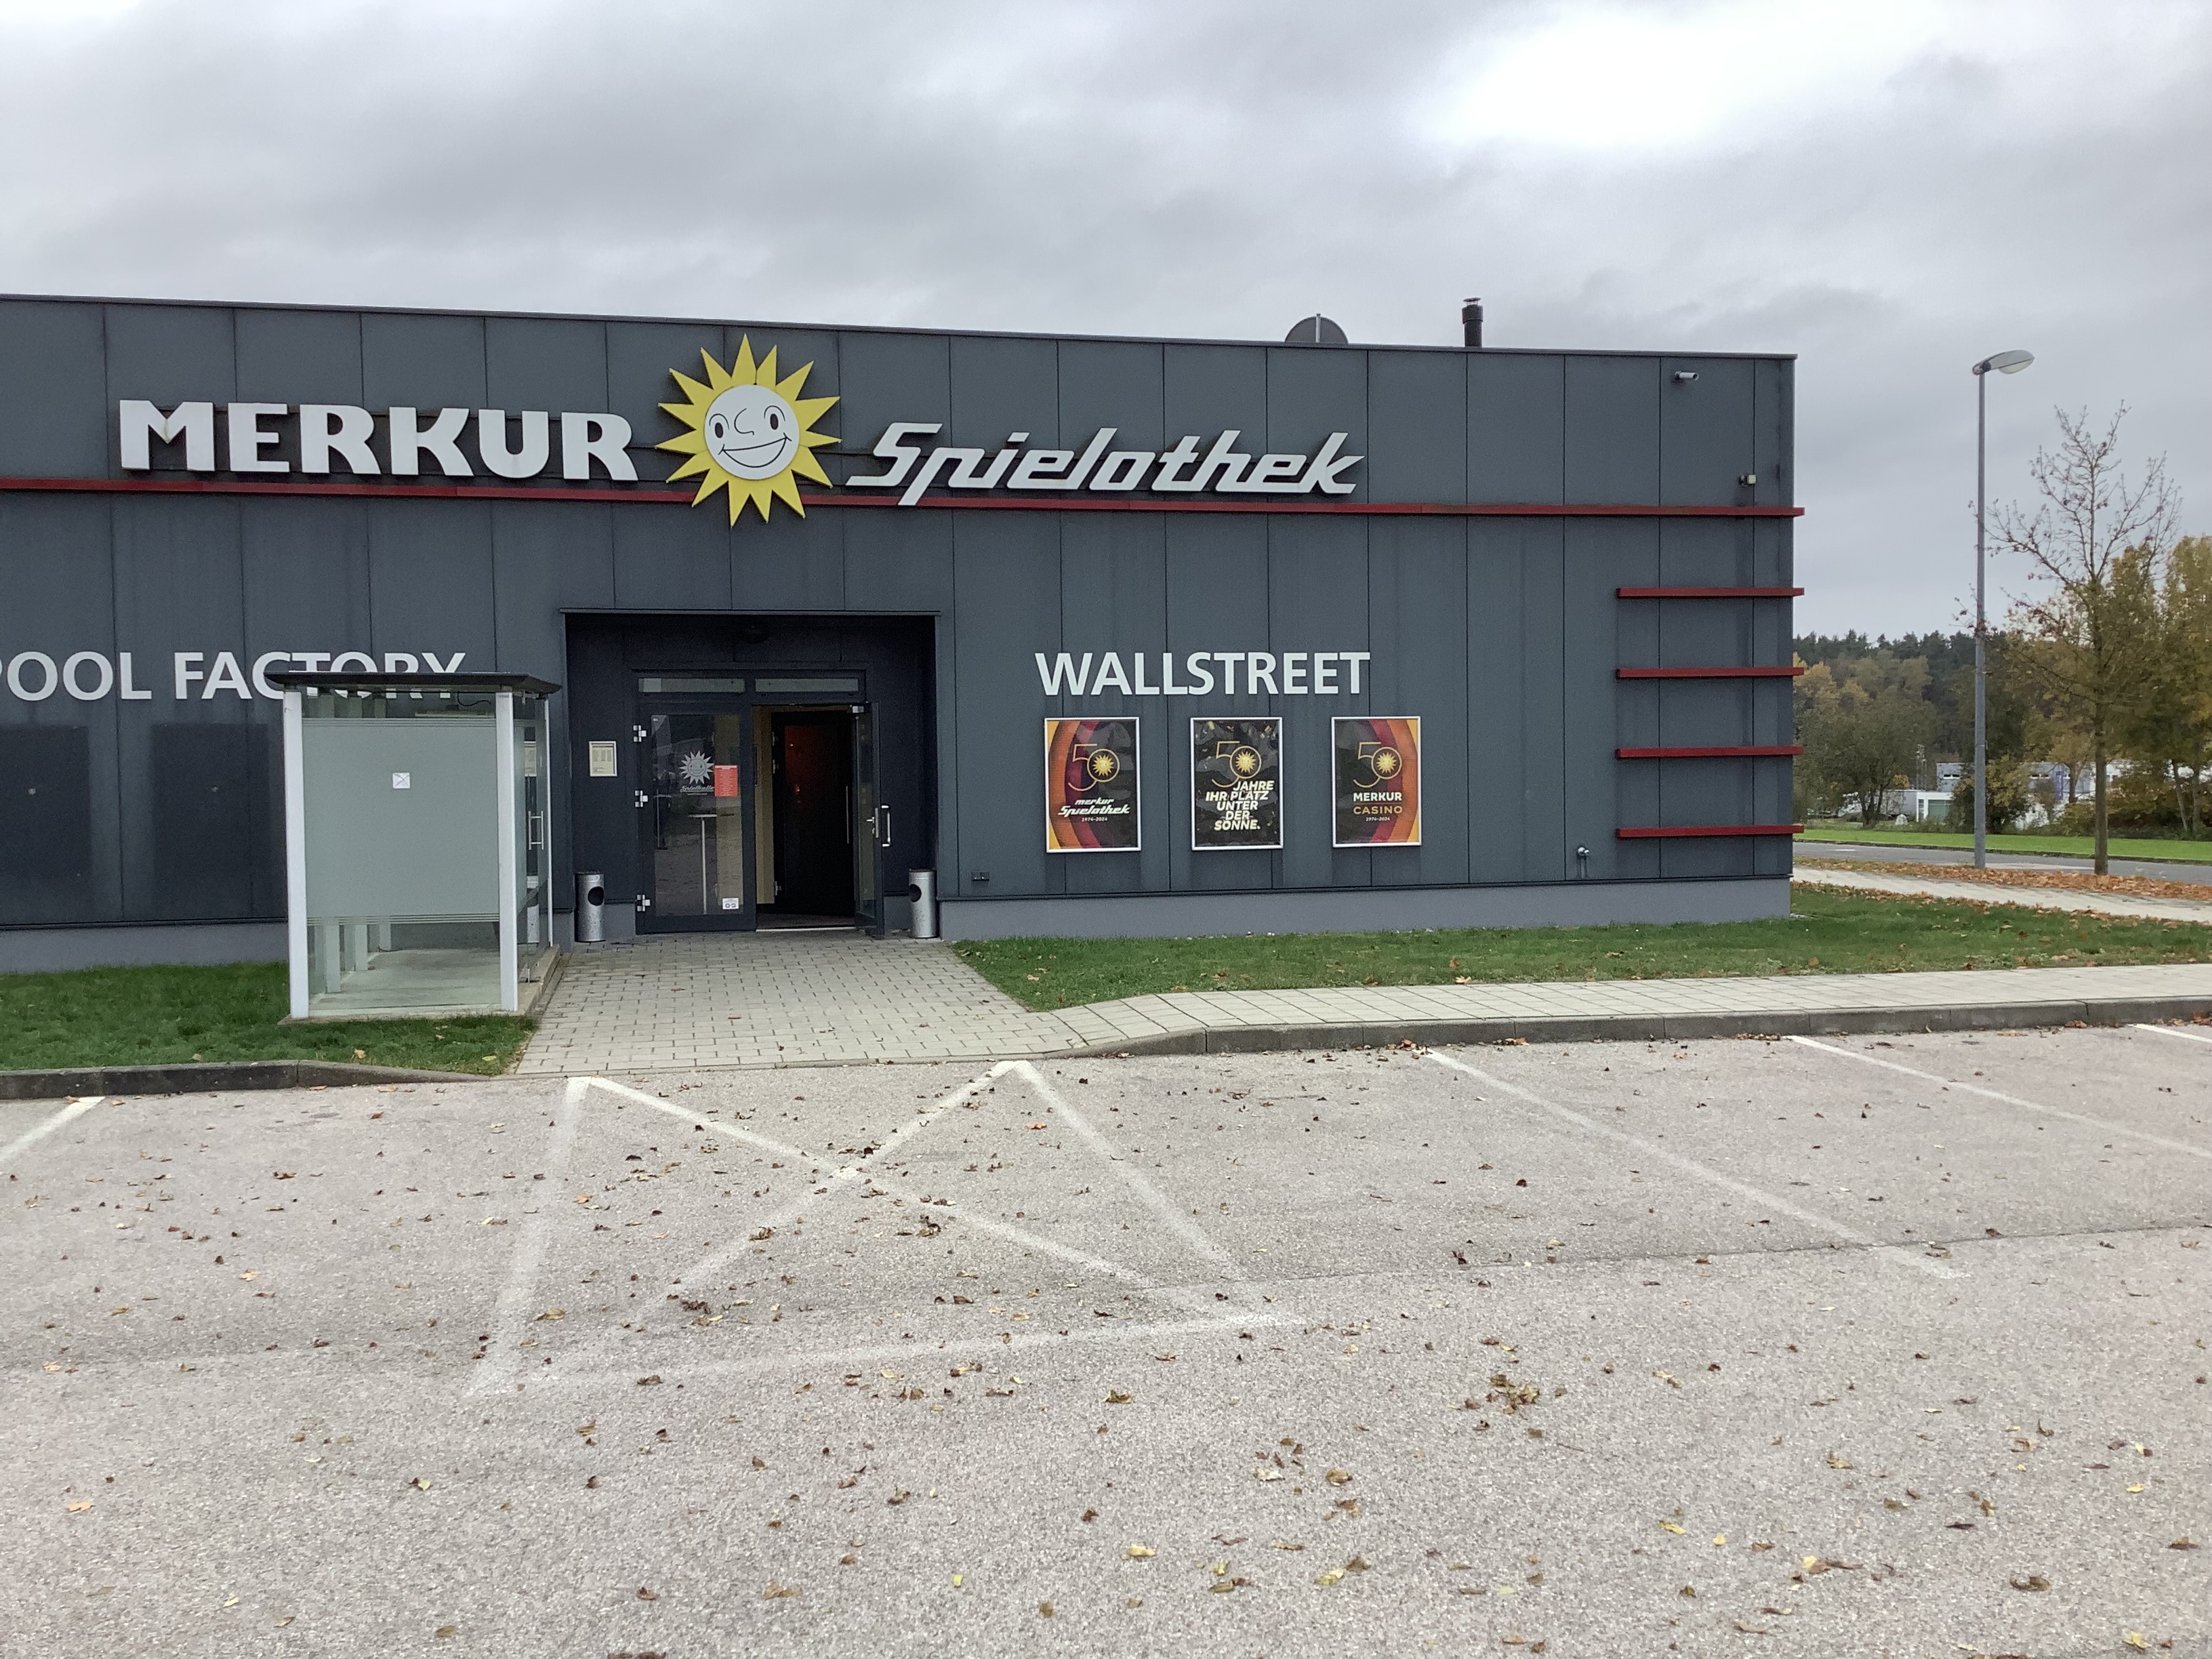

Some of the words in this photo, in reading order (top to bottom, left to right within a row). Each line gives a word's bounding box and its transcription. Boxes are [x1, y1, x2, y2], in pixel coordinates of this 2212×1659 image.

[119, 399, 638, 480] MERKUR
[845, 422, 1365, 506] Spielothek
[0, 651, 152, 701] OOL
[1034, 651, 1371, 696] WALLSTREET
[1068, 743, 1120, 792] 50
[1212, 741, 1262, 787] 50
[1353, 741, 1402, 788] 50
[1233, 781, 1275, 791] JAHRE
[1075, 797, 1114, 805] merkur
[1206, 792, 1227, 801] IHR
[1230, 791, 1269, 801] PLATZ
[1353, 792, 1402, 802] MERKUR
[1058, 804, 1130, 817] Spielothek
[1216, 800, 1258, 811] UNTER
[1353, 806, 1403, 815] CASINO
[1225, 811, 1250, 821] DER
[1214, 819, 1261, 830] SONNE.
